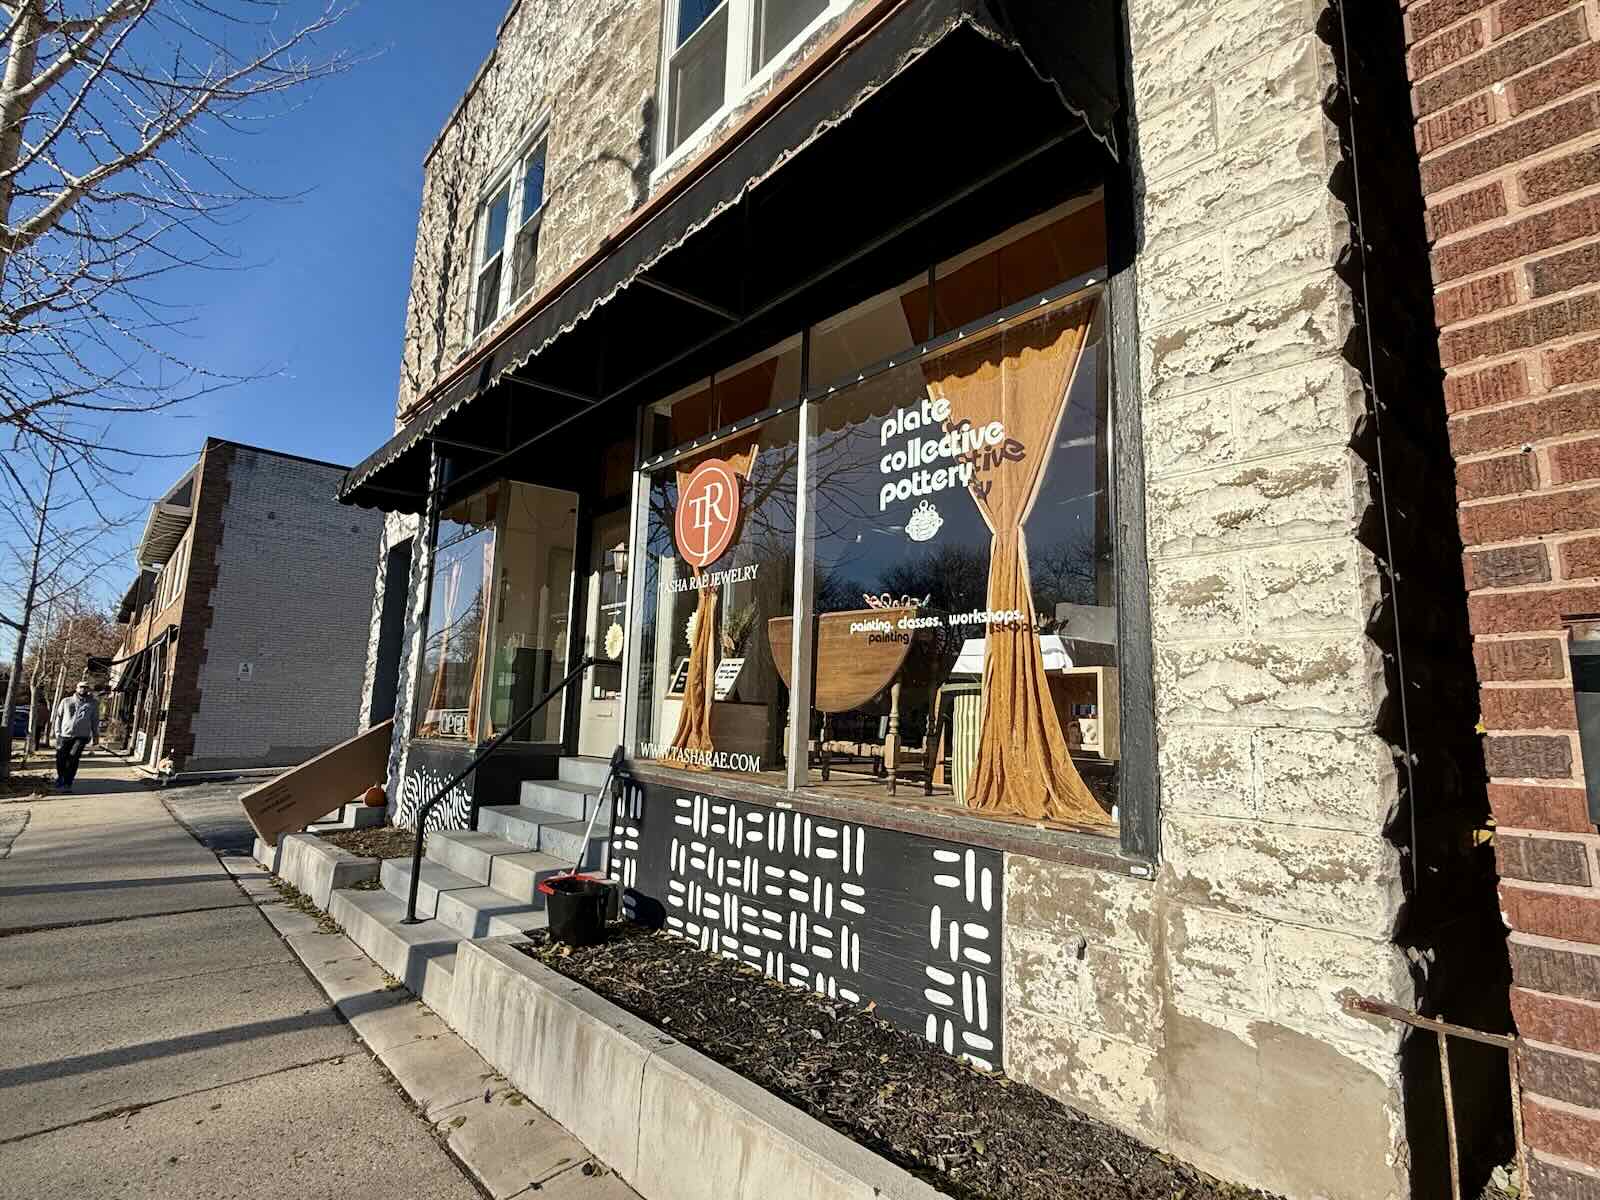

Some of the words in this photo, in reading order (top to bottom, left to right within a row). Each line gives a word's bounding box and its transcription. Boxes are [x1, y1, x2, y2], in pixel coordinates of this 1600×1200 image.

[880, 398, 951, 446] plate
[880, 421, 1005, 474] collective
[880, 462, 973, 511] pottery
[689, 573, 709, 590] RAE
[710, 564, 759, 587] JEWELRY
[850, 618, 894, 635] painting.
[897, 615, 943, 631] classes.
[949, 608, 1025, 626] workshops.
[640, 742, 761, 773] WWW.TASHARAE.COM
